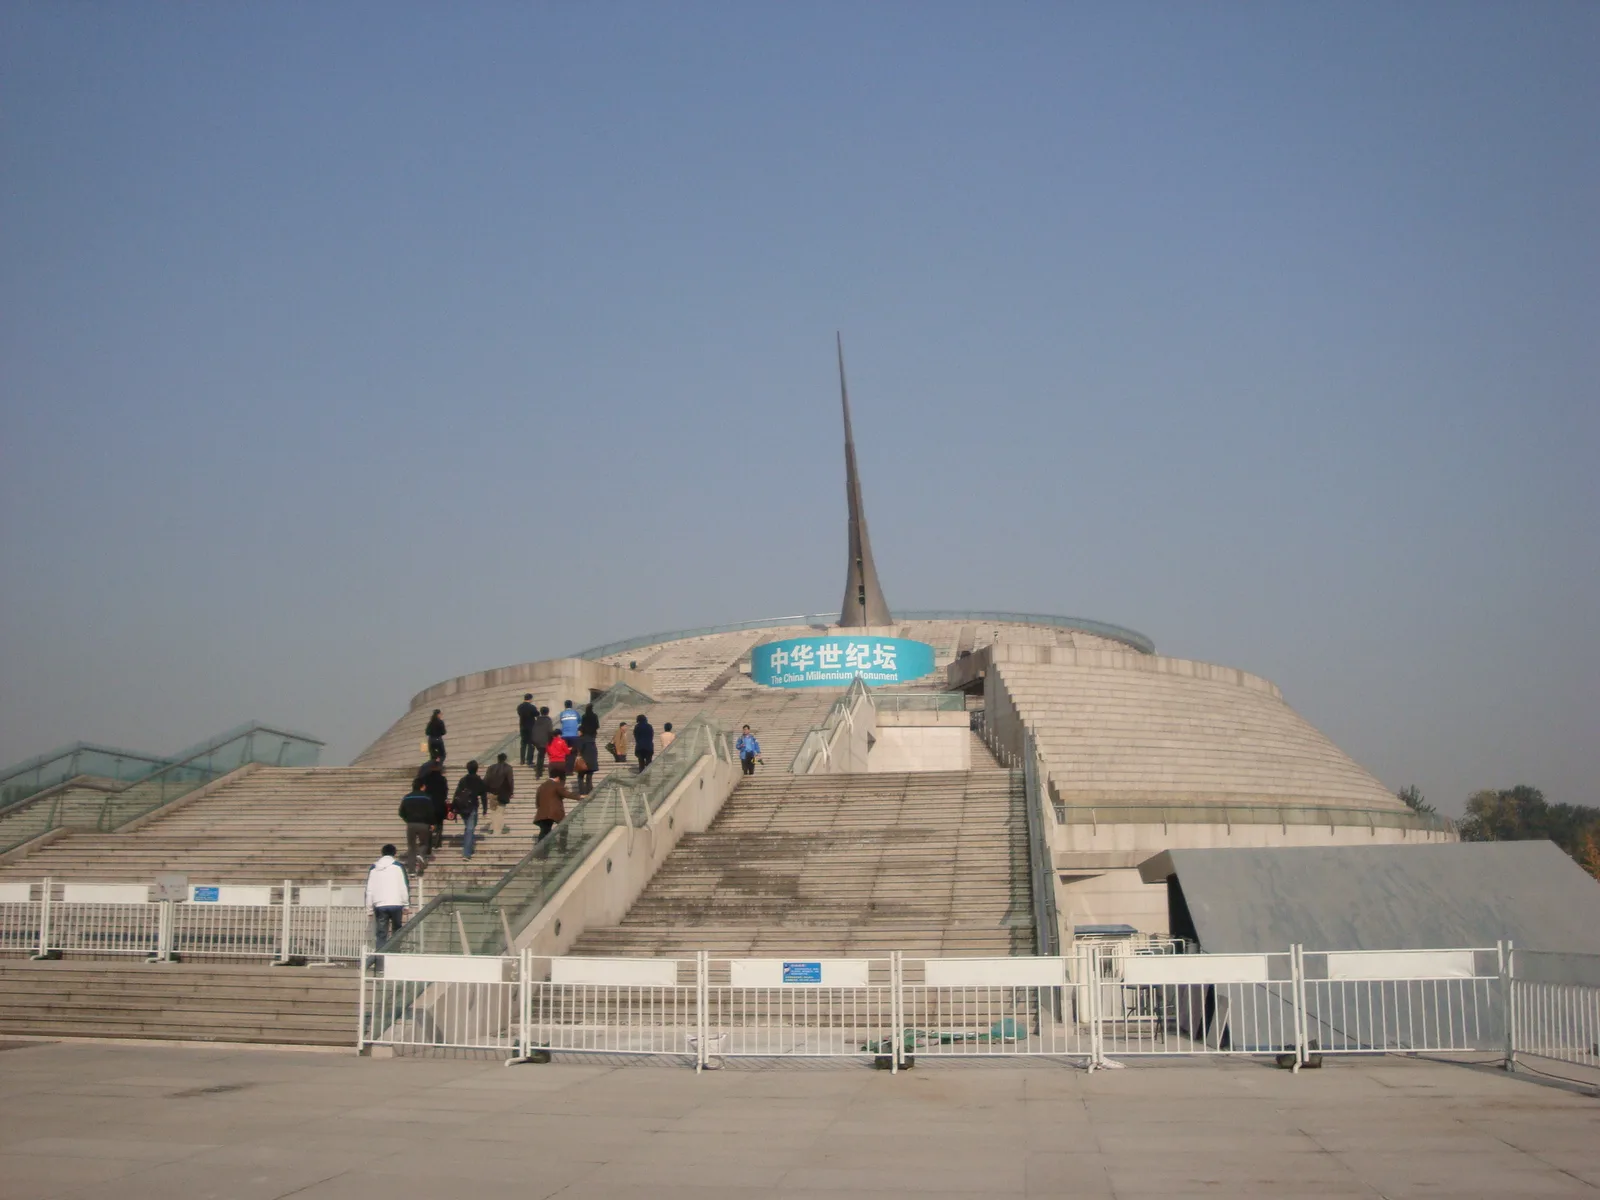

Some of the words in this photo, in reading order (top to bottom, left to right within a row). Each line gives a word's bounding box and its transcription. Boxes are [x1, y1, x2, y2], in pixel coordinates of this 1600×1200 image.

[771, 642, 897, 674] 中华世纪坛
[771, 675, 783, 685] The
[784, 672, 804, 683] China
[806, 671, 853, 681] Millennium
[855, 670, 898, 681] Monument
